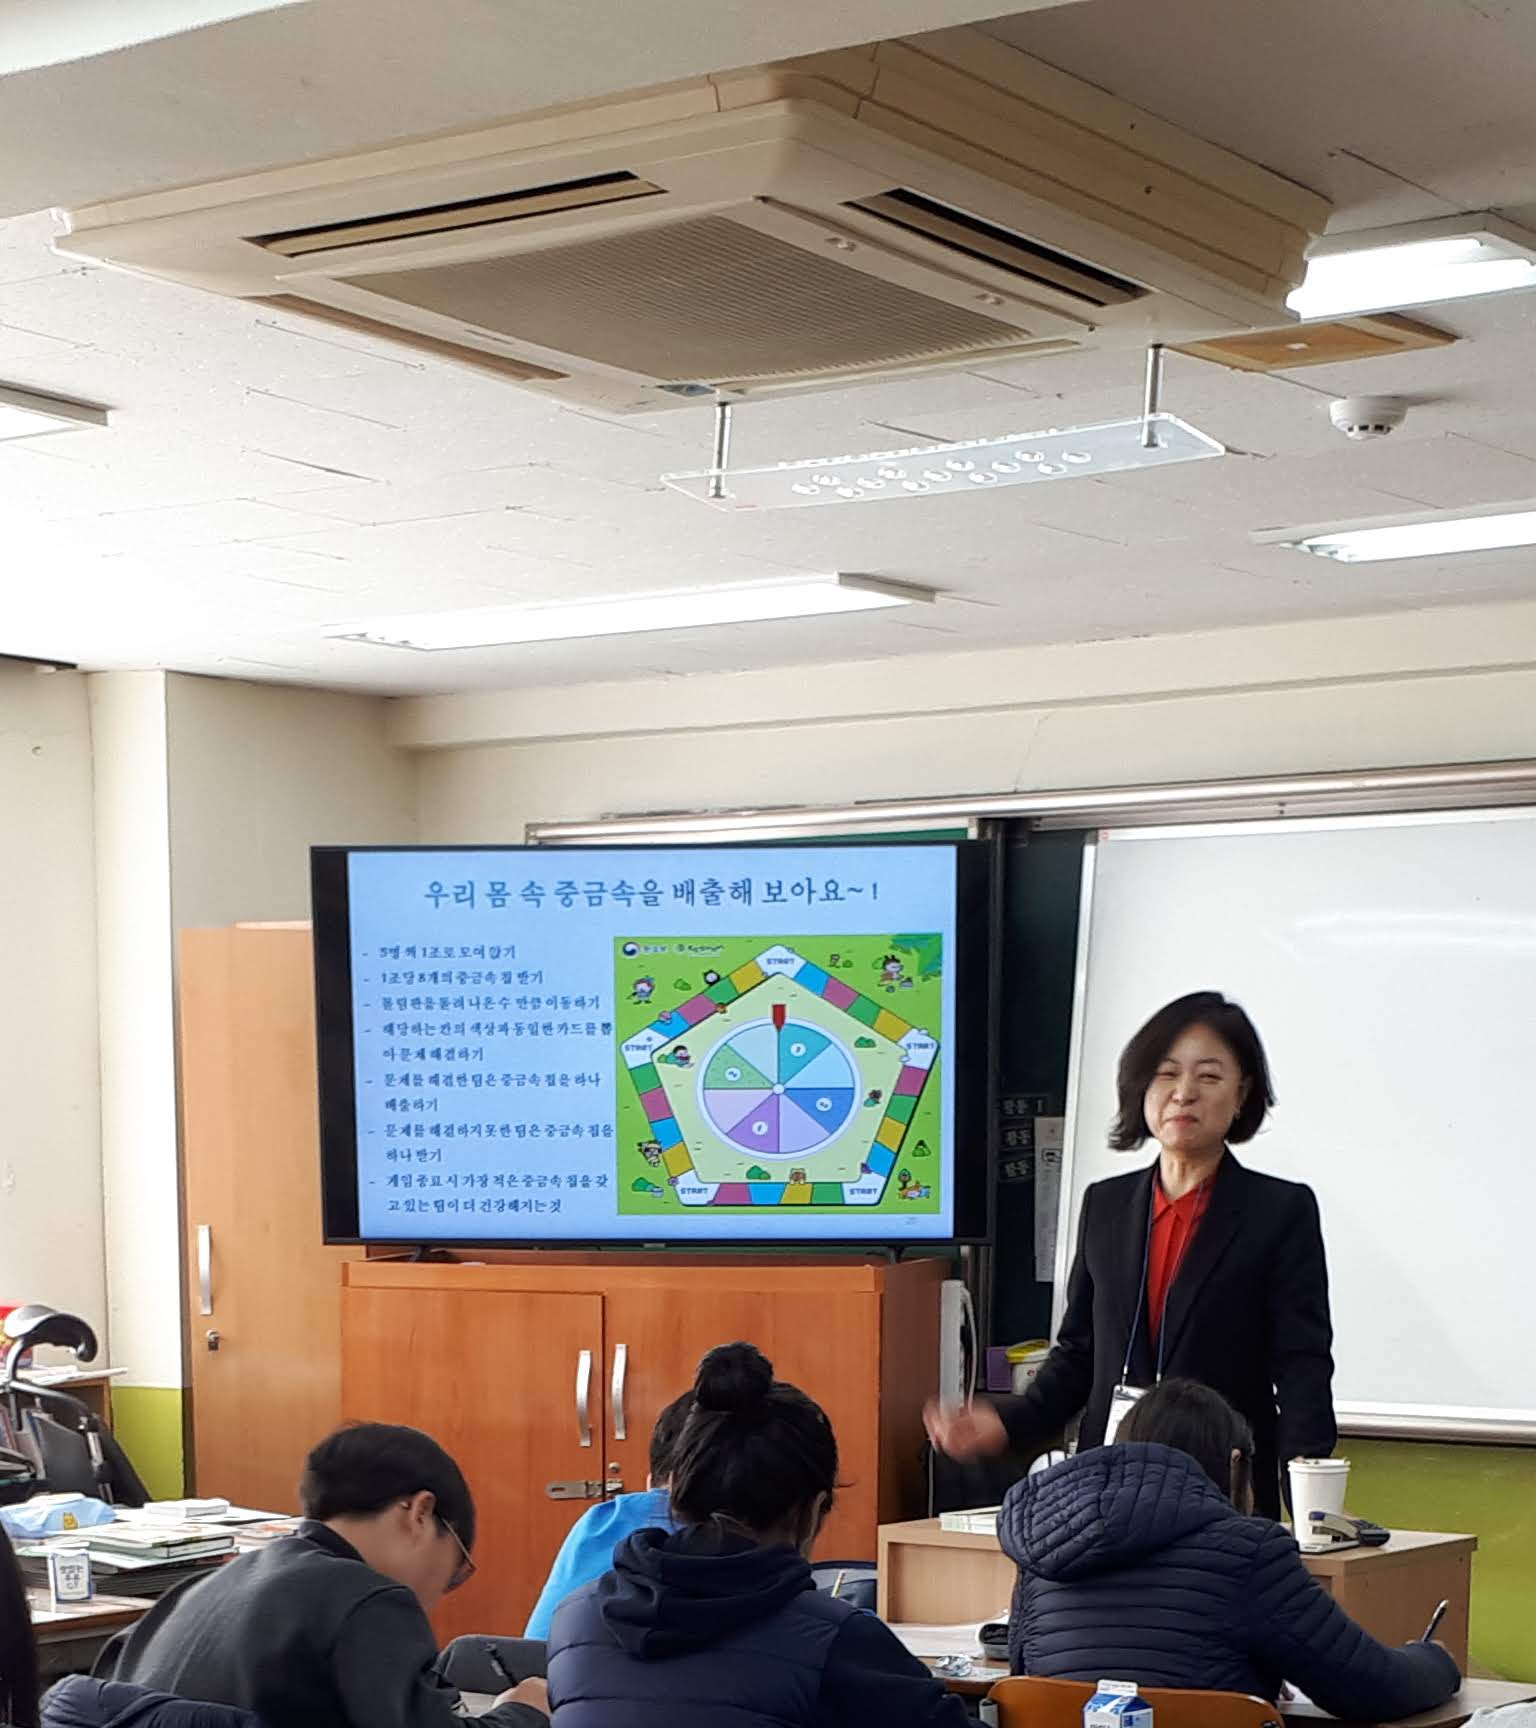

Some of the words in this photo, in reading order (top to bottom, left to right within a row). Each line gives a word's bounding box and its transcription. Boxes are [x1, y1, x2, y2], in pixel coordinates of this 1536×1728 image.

[424, 879, 475, 909] 우리
[486, 881, 512, 908] 몸
[520, 880, 546, 908] 속
[553, 879, 663, 908] 중금속을
[672, 877, 753, 907] 배출해
